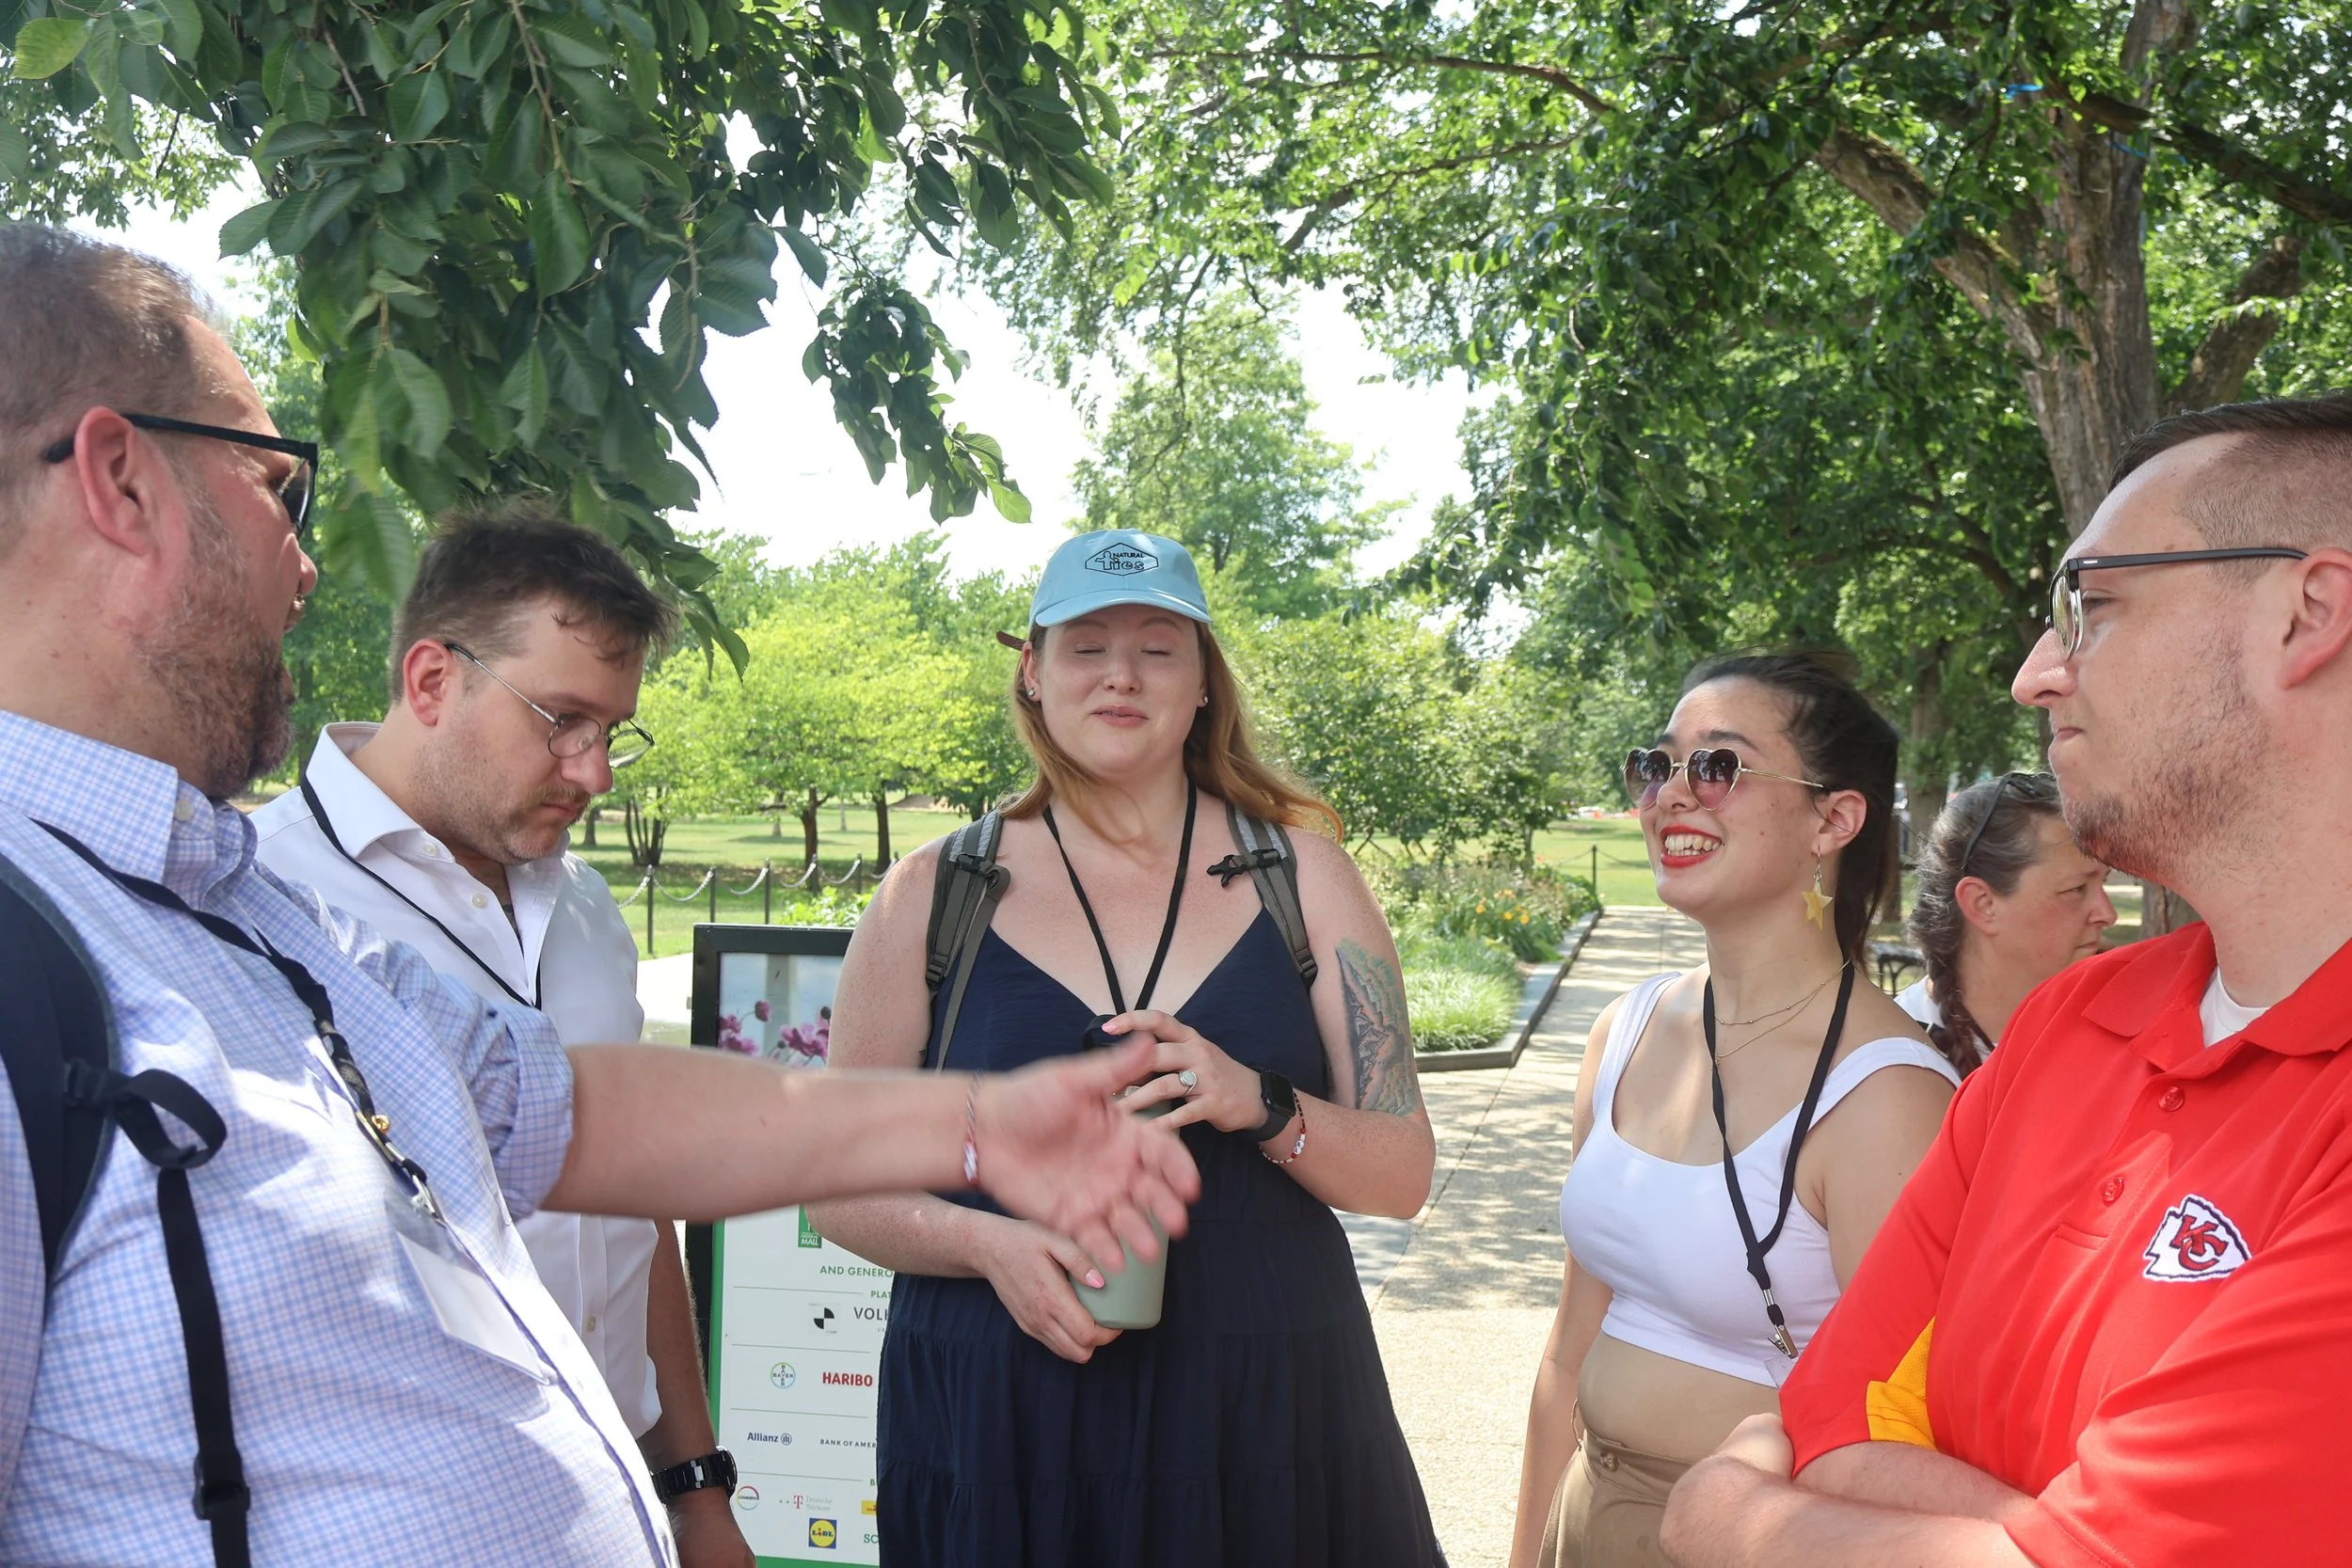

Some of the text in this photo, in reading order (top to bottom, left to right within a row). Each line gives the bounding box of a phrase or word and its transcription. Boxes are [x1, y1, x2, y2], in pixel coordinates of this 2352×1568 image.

[2170, 1214, 2229, 1272] KC
[819, 1265, 894, 1277] AND GENERO
[822, 1372, 873, 1386] HARIBO
[747, 1433, 779, 1443] Allianz
